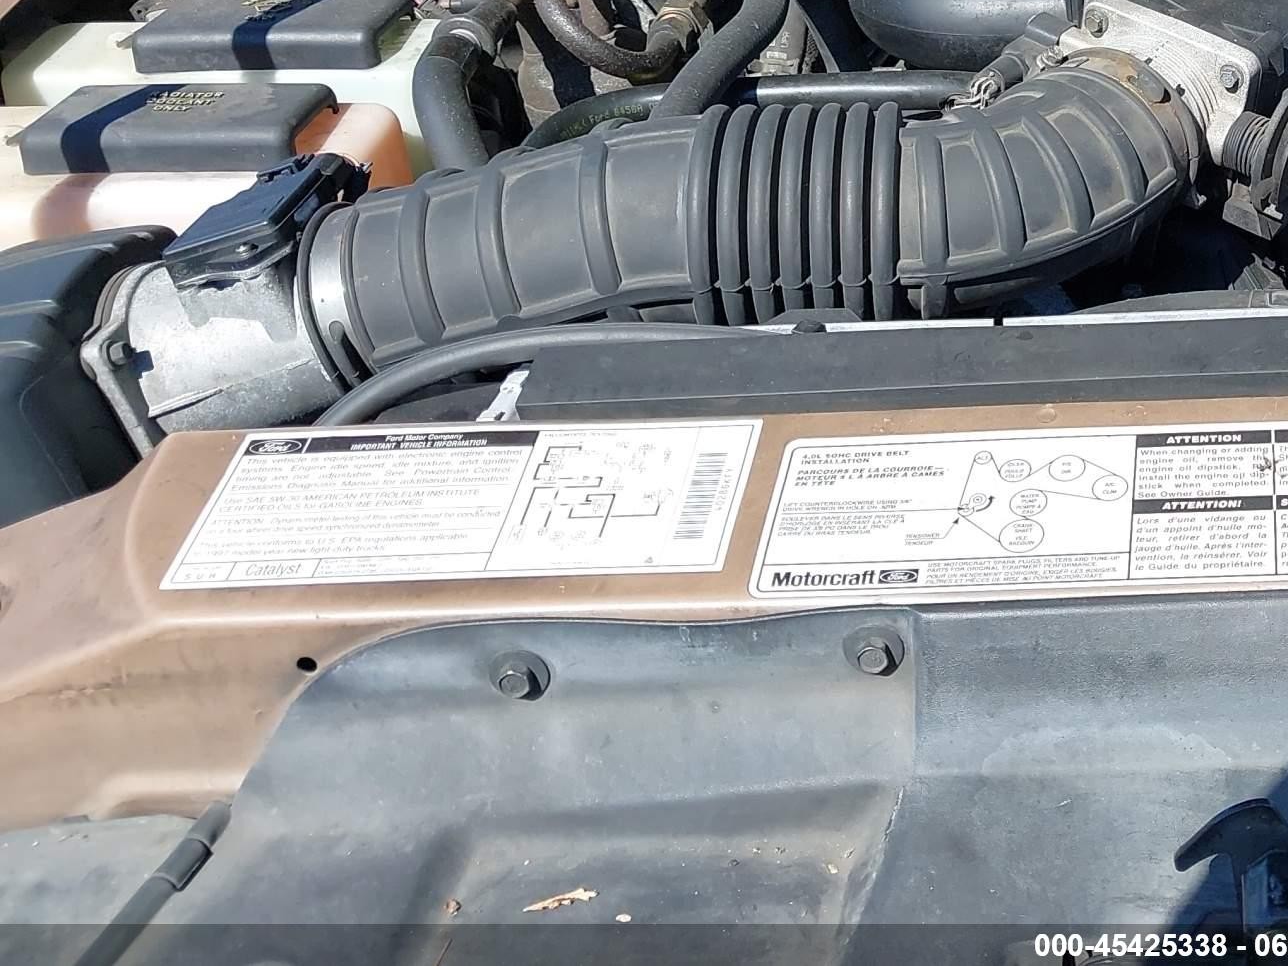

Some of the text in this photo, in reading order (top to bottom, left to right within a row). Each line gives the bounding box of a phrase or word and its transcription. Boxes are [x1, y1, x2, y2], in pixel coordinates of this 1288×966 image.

[152, 104, 191, 112] ONLY
[383, 432, 464, 443] Ford Motor Company
[1166, 434, 1242, 443] ATTENTION
[256, 440, 294, 452] Ford
[350, 442, 396, 451] IMPORTANT
[432, 439, 488, 448] INFORMATION
[1234, 446, 1269, 454] adding
[1160, 490, 1192, 498] Owner
[1196, 489, 1230, 497] Guide.
[1162, 500, 1242, 509] ATTENTION!
[245, 561, 302, 577] Catalyst
[772, 570, 875, 586] Motorcraft
